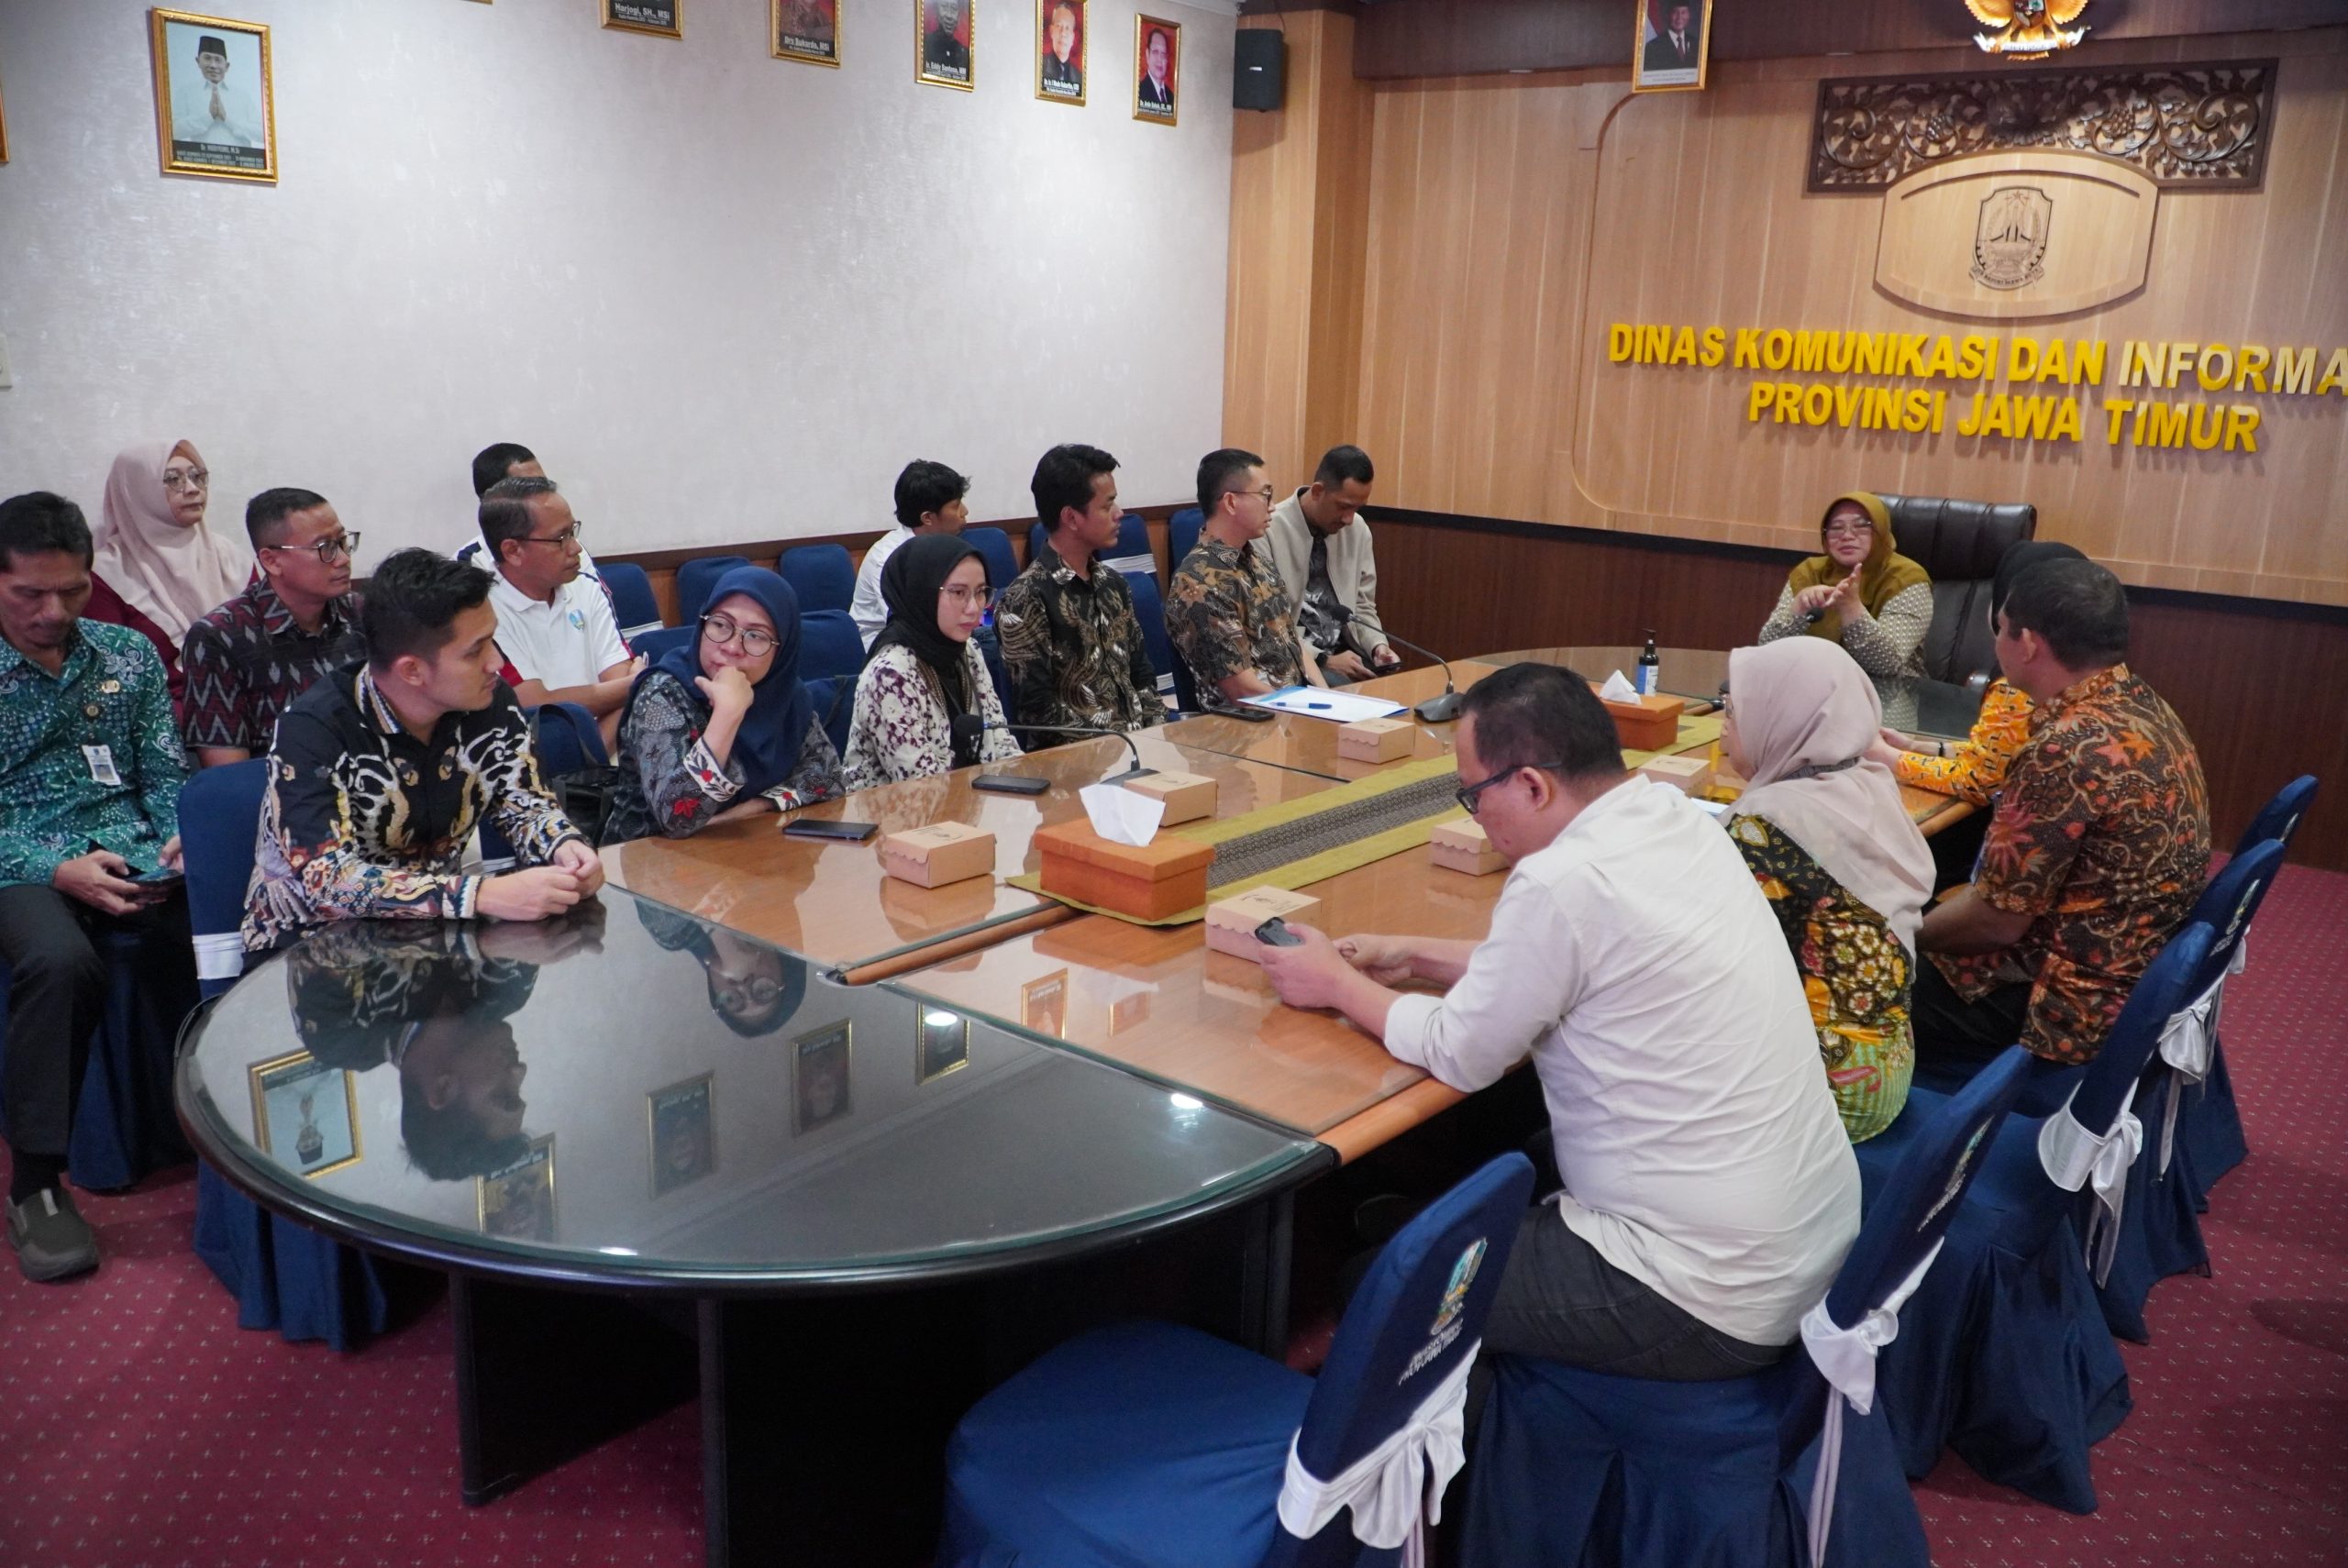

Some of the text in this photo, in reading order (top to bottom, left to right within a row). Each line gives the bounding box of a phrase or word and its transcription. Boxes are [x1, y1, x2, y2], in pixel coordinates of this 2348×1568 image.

[1608, 323, 2348, 396] DINAS KOMUNIKASI DAN INFORMA
[1748, 381, 2261, 453] PROVINSI JAWA TIMUR
